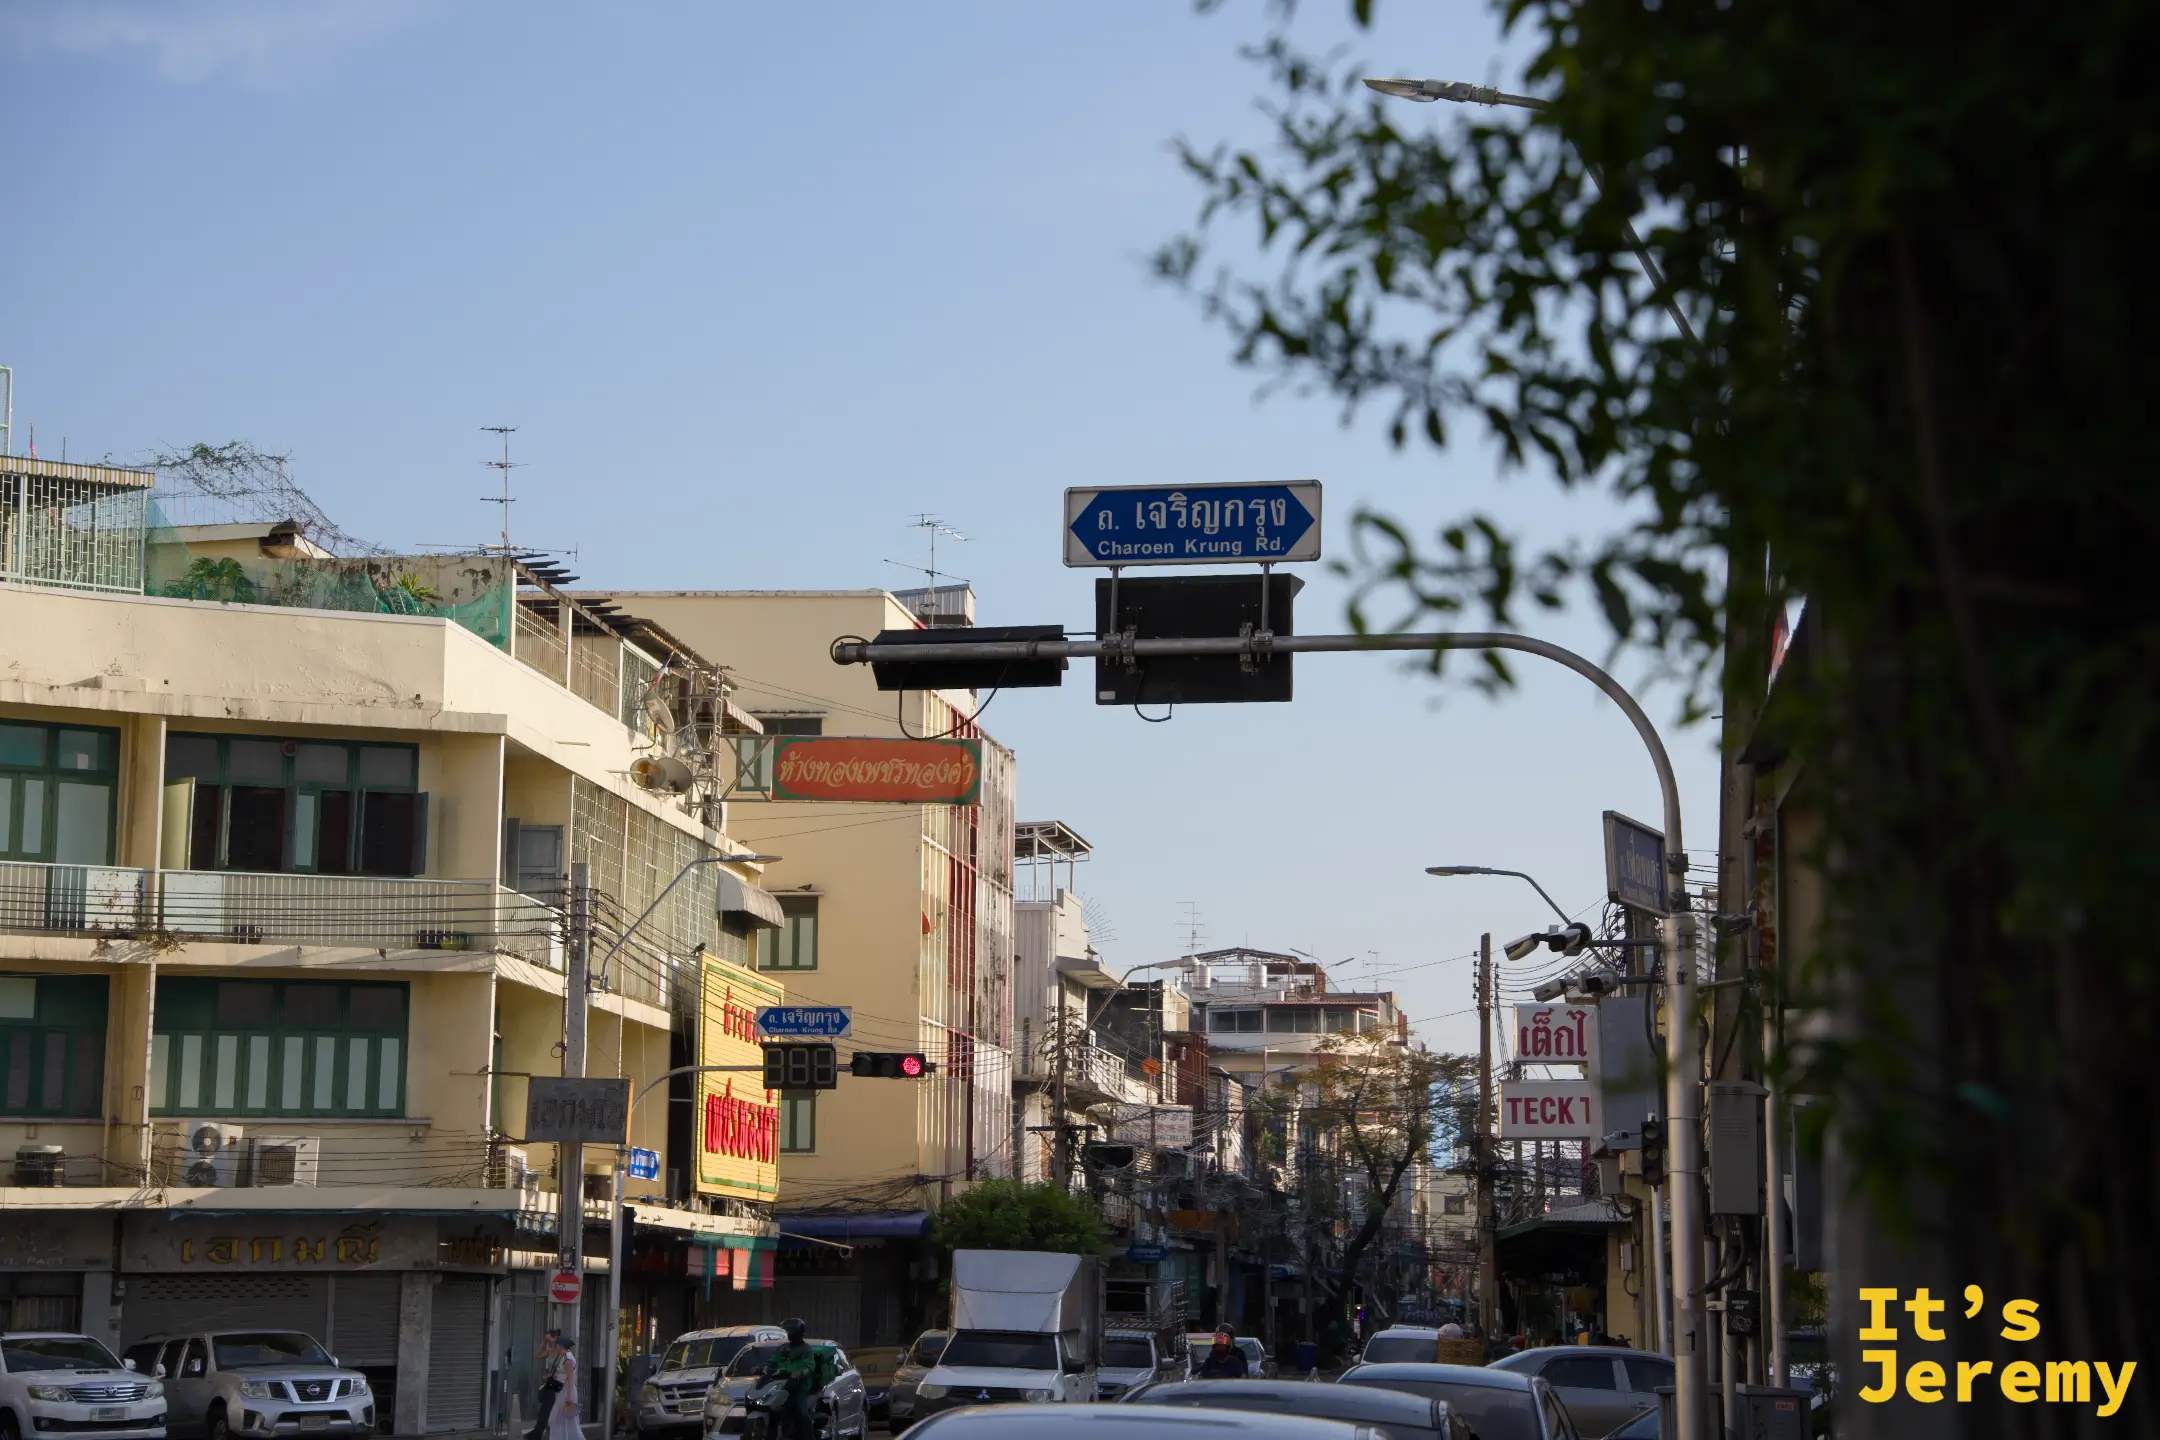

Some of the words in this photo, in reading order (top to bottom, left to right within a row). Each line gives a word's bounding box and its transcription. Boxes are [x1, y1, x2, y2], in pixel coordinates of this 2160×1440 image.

[1098, 509, 1120, 530] ถ.
[1136, 492, 1286, 536] เจริญกรุง
[1097, 540, 1174, 555] Charoen
[1185, 539, 1242, 554] Krung
[1255, 537, 1285, 551] Rd.
[768, 1014, 778, 1024] ถ.
[782, 1008, 840, 1028] เจริญกรุง
[802, 1026, 824, 1035] Krung
[1506, 1096, 1576, 1125] TECK
[181, 1221, 379, 1264] เอกมณี
